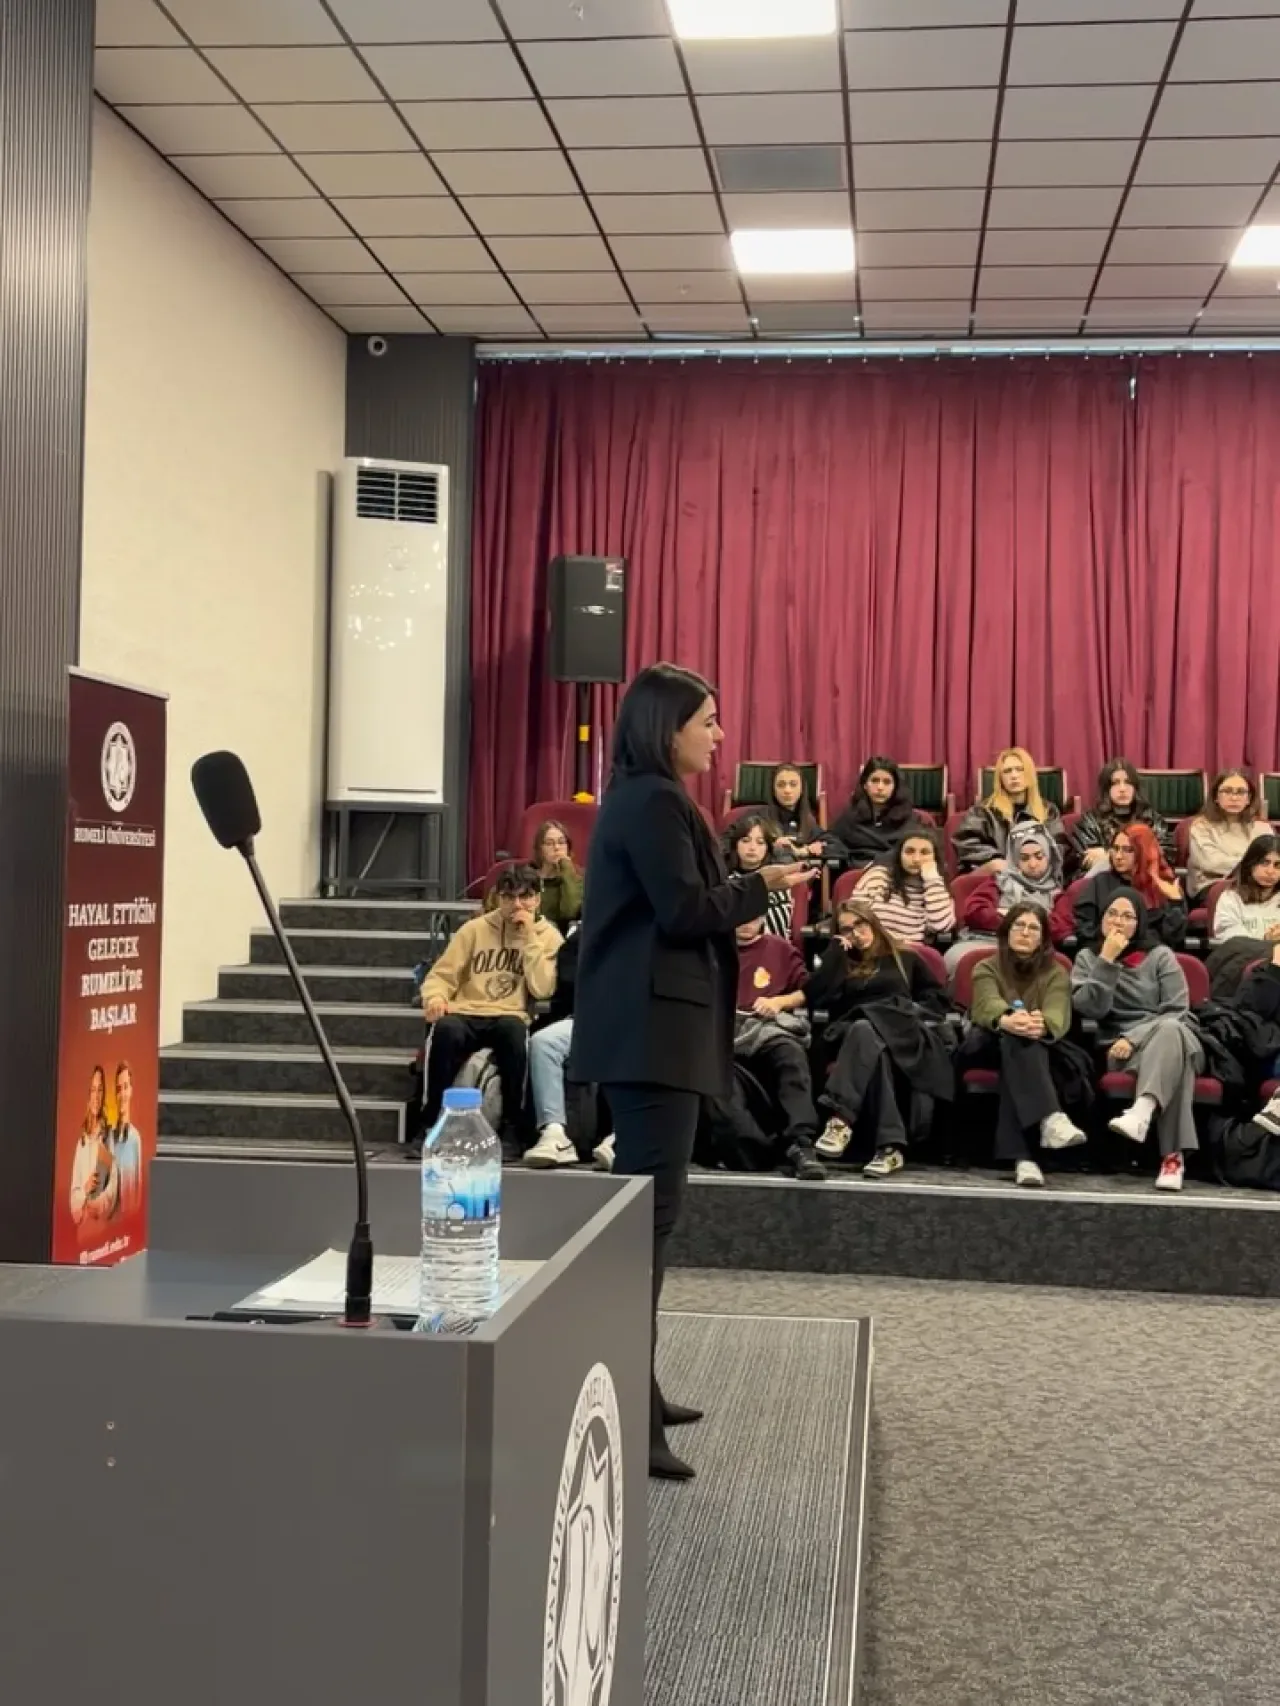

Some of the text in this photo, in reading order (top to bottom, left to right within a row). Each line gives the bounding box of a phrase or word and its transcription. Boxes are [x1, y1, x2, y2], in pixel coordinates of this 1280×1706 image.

[68, 903, 110, 926] HAYAL
[88, 936, 139, 961] GELECEK
[80, 965, 142, 997] RUMELİ'DE
[90, 1003, 137, 1034] BAŞLAR
